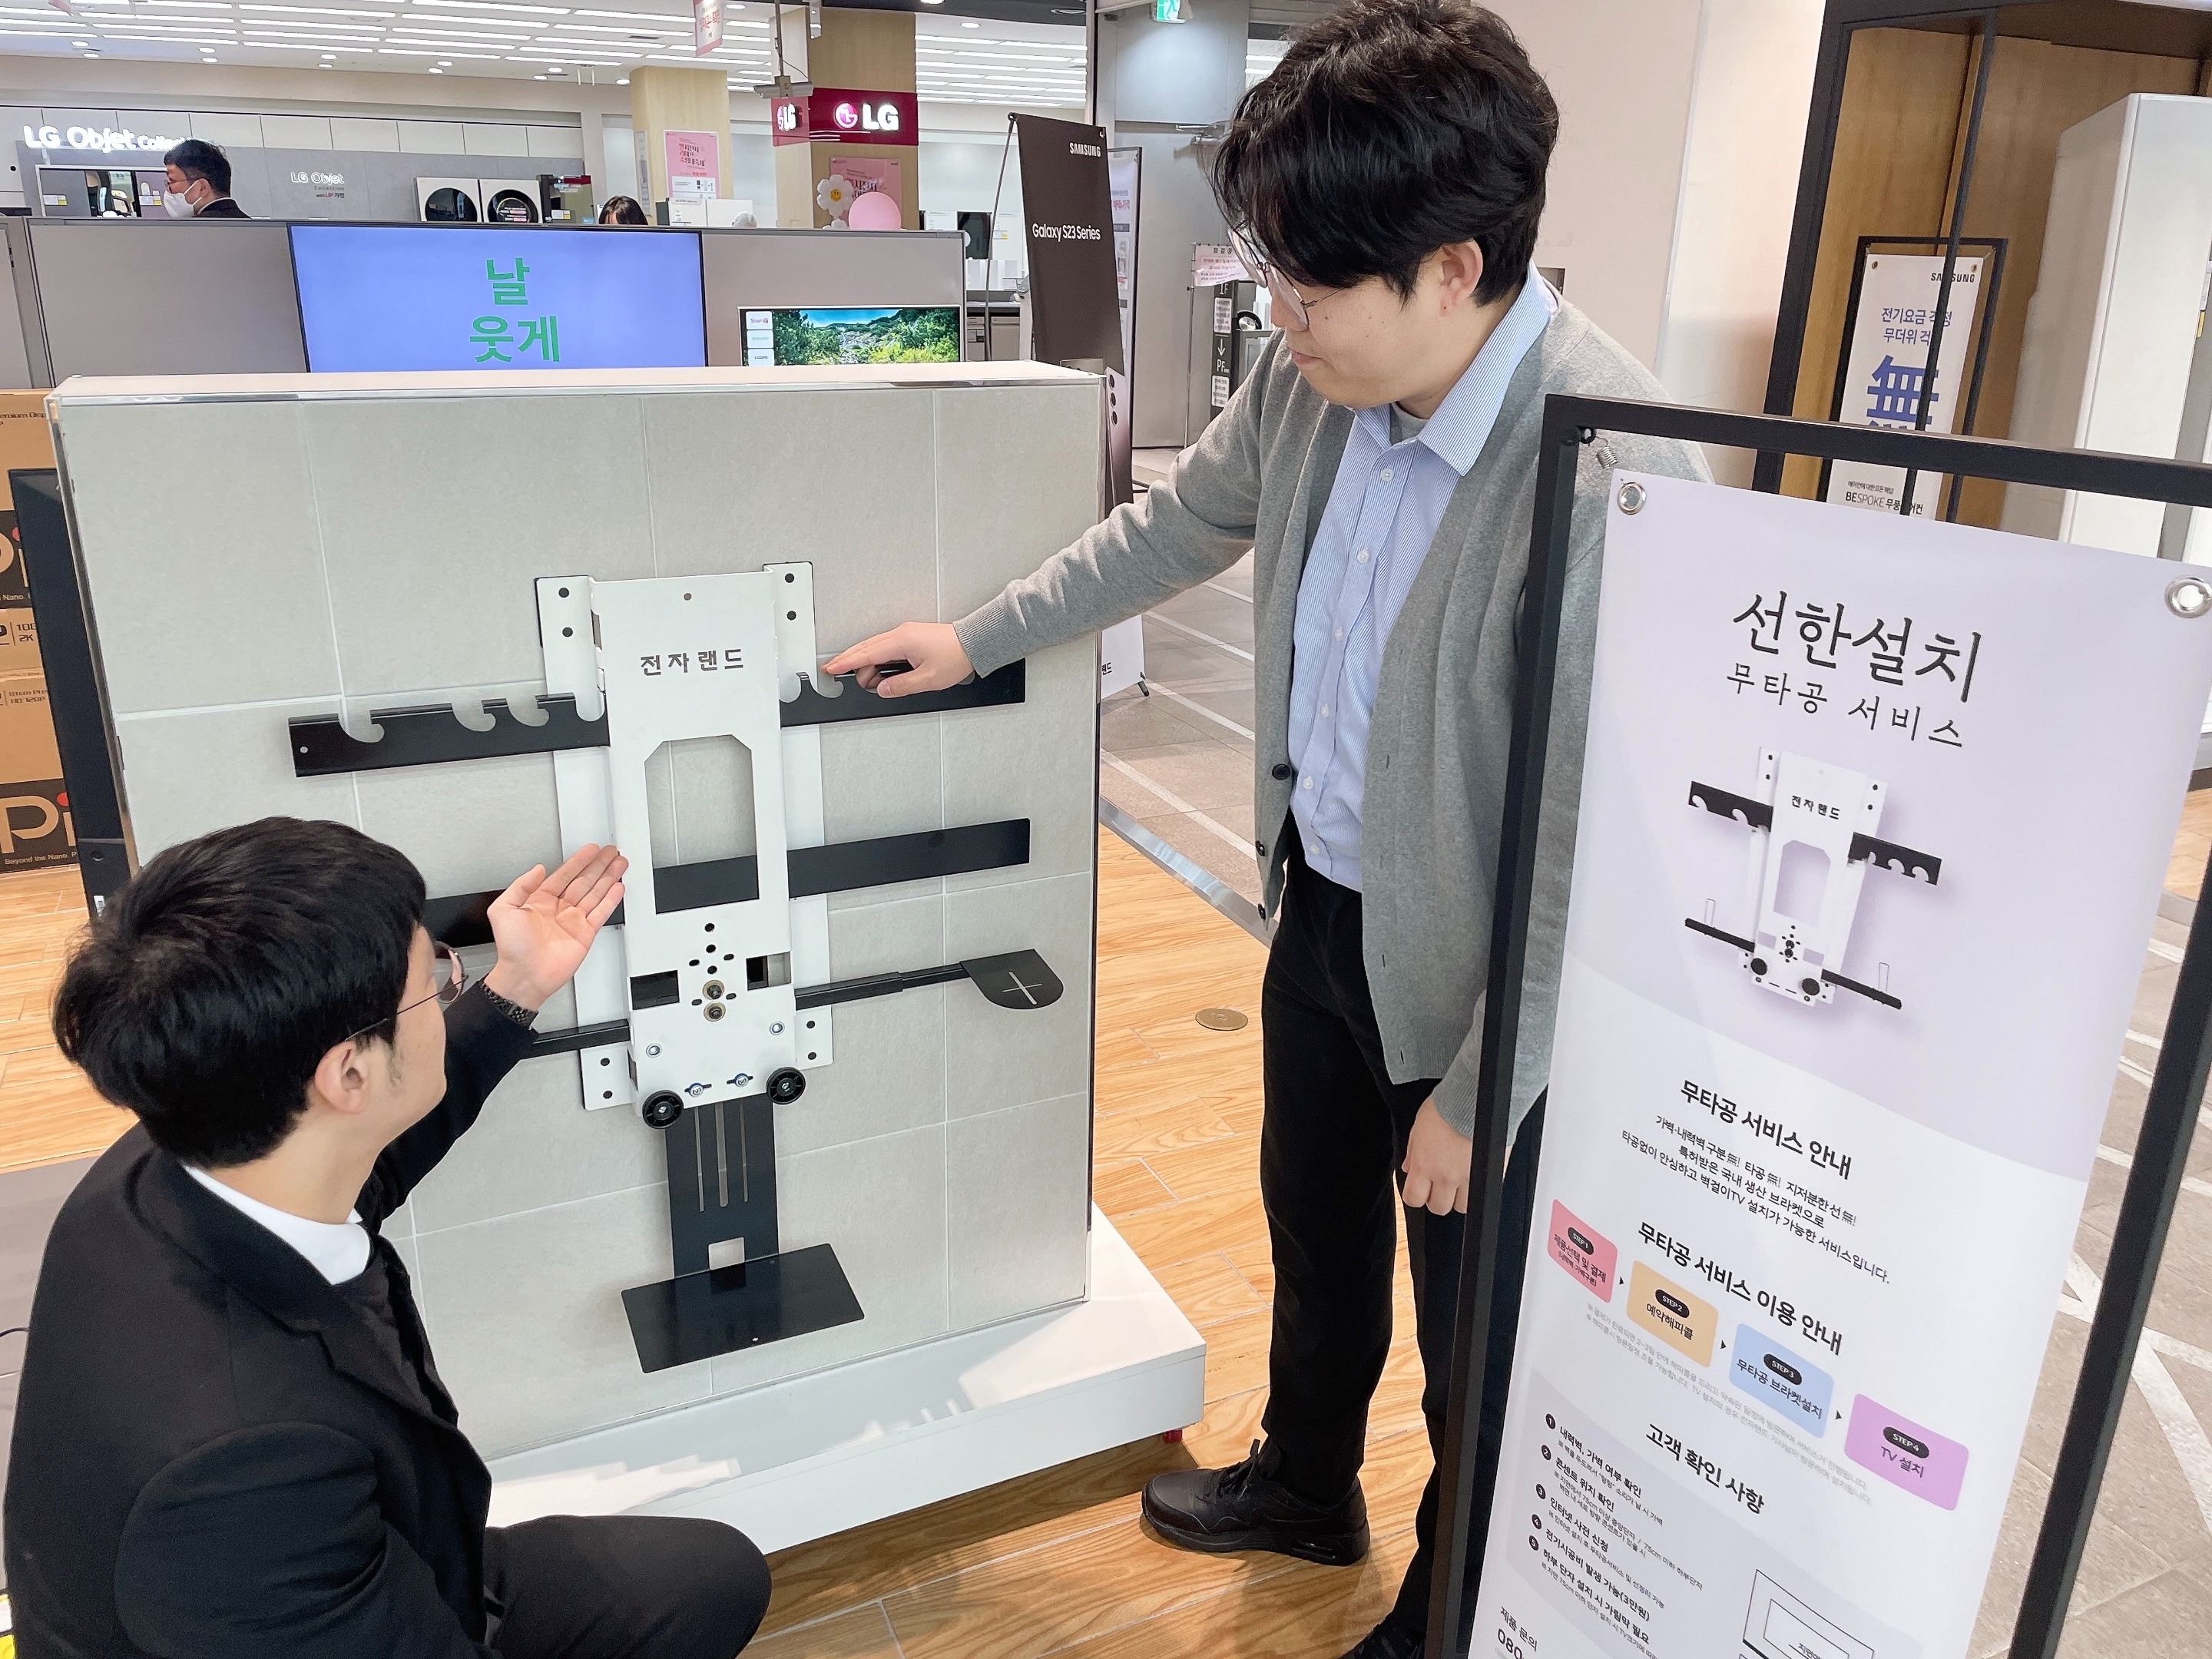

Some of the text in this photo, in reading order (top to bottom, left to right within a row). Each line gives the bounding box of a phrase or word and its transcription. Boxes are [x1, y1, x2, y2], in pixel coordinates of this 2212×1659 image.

[23, 125, 137, 154] LG Objet
[862, 103, 899, 131] LG
[1069, 142, 1101, 157] SAMSUNG
[290, 171, 345, 186] LG Objet
[1032, 223, 1061, 243] Galaxy
[1062, 224, 1076, 240] S23
[1076, 224, 1101, 240] Series
[485, 257, 530, 306] 날
[1930, 272, 1975, 283] SASUNG
[469, 315, 560, 363] 웃게
[1881, 307, 1926, 325] 전기요금
[1883, 327, 1918, 345] 무더위
[1845, 491, 1923, 515] BESPOKE 무풍어컨
[18, 634, 35, 643] 2K
[1733, 591, 1982, 703] 선한설치
[640, 648, 743, 677] 전자랜드
[1727, 662, 1962, 748] 무타공 서비스
[1791, 795, 1840, 820] 전자랜드
[5, 856, 32, 865] Beyond
[1680, 1079, 1853, 1180] 무타공 서비스 안내
[1678, 1145, 1825, 1229] 특허받은 국내 생산 브라켓으로
[1706, 1142, 1727, 1161] 구분
[1744, 1161, 1766, 1180] 타공
[1786, 1181, 1830, 1213] 지저분한
[1830, 1204, 1842, 1220] 선
[1622, 1130, 1890, 1284] 타공없이 안심하고 벽걸이TV 설치가 가능한 서비스입니다.
[1581, 1257, 1589, 1271] 및
[1591, 1263, 1607, 1284] 결제
[1637, 1221, 1843, 1356] 무타공 서비스 이용 안내
[1646, 1303, 1694, 1340] 예약해피콜
[1737, 1358, 1823, 1420] 무타공 브라켓설치
[1555, 1456, 1614, 1512] 콘센트 위치 확인
[1587, 1449, 1604, 1469] 가벽
[1604, 1464, 1622, 1482] 여부
[1623, 1477, 1642, 1498] 확인
[1646, 1422, 1765, 1515] 고객 확인 사항
[1880, 1446, 1925, 1479] TV 설치
[1550, 1497, 1609, 1553] 인터넷 사전 신청
[1543, 1548, 1650, 1645] 하부 단자 설치 시 가림막 필요
[1545, 1528, 1650, 1622] 전기시공비 발생 가능(3만원)
[1500, 1605, 1518, 1632] 제품
[1518, 1626, 1538, 1652] 문의
